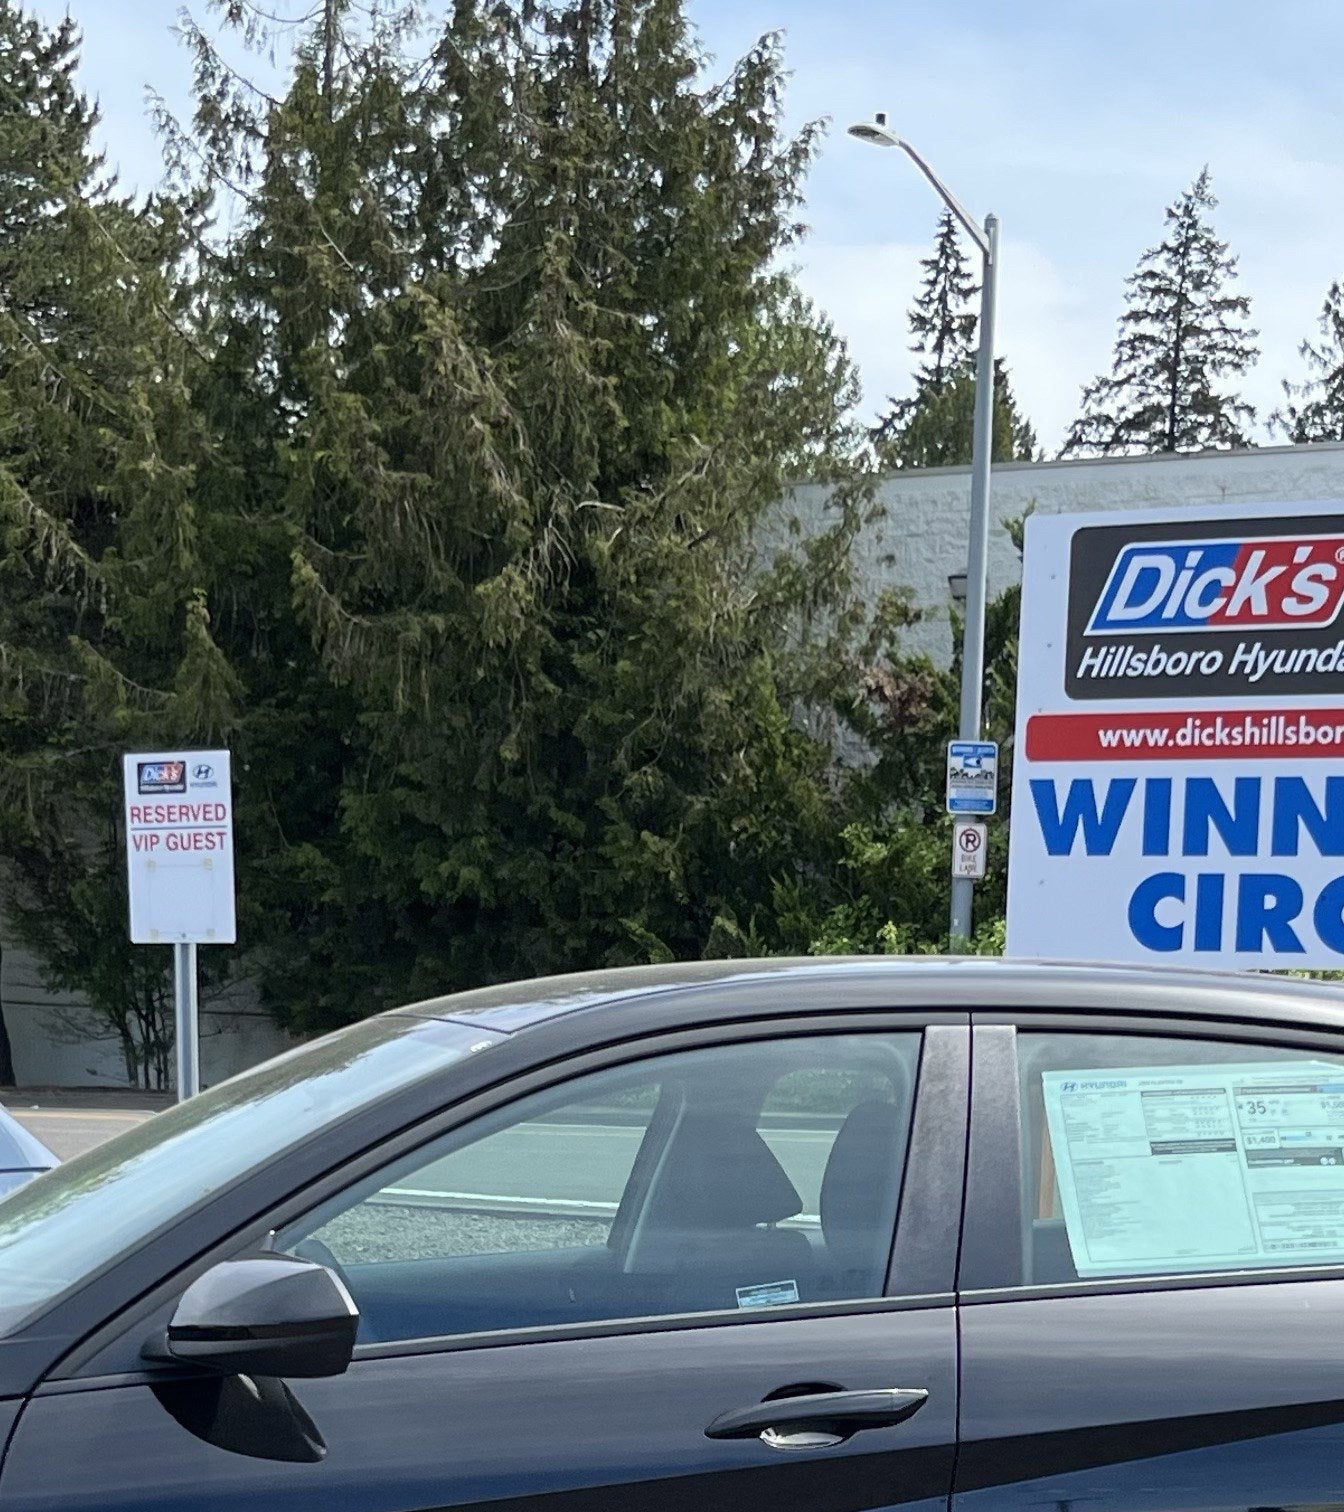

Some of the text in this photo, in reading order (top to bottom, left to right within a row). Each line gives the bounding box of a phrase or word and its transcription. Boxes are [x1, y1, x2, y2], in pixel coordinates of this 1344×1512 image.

[1106, 546, 1338, 621] Dick's
[1076, 644, 1224, 679] Hillsboro
[130, 803, 227, 825] RESERVED
[132, 832, 227, 852] VIP GUEST
[1247, 1101, 1267, 1115] 35
